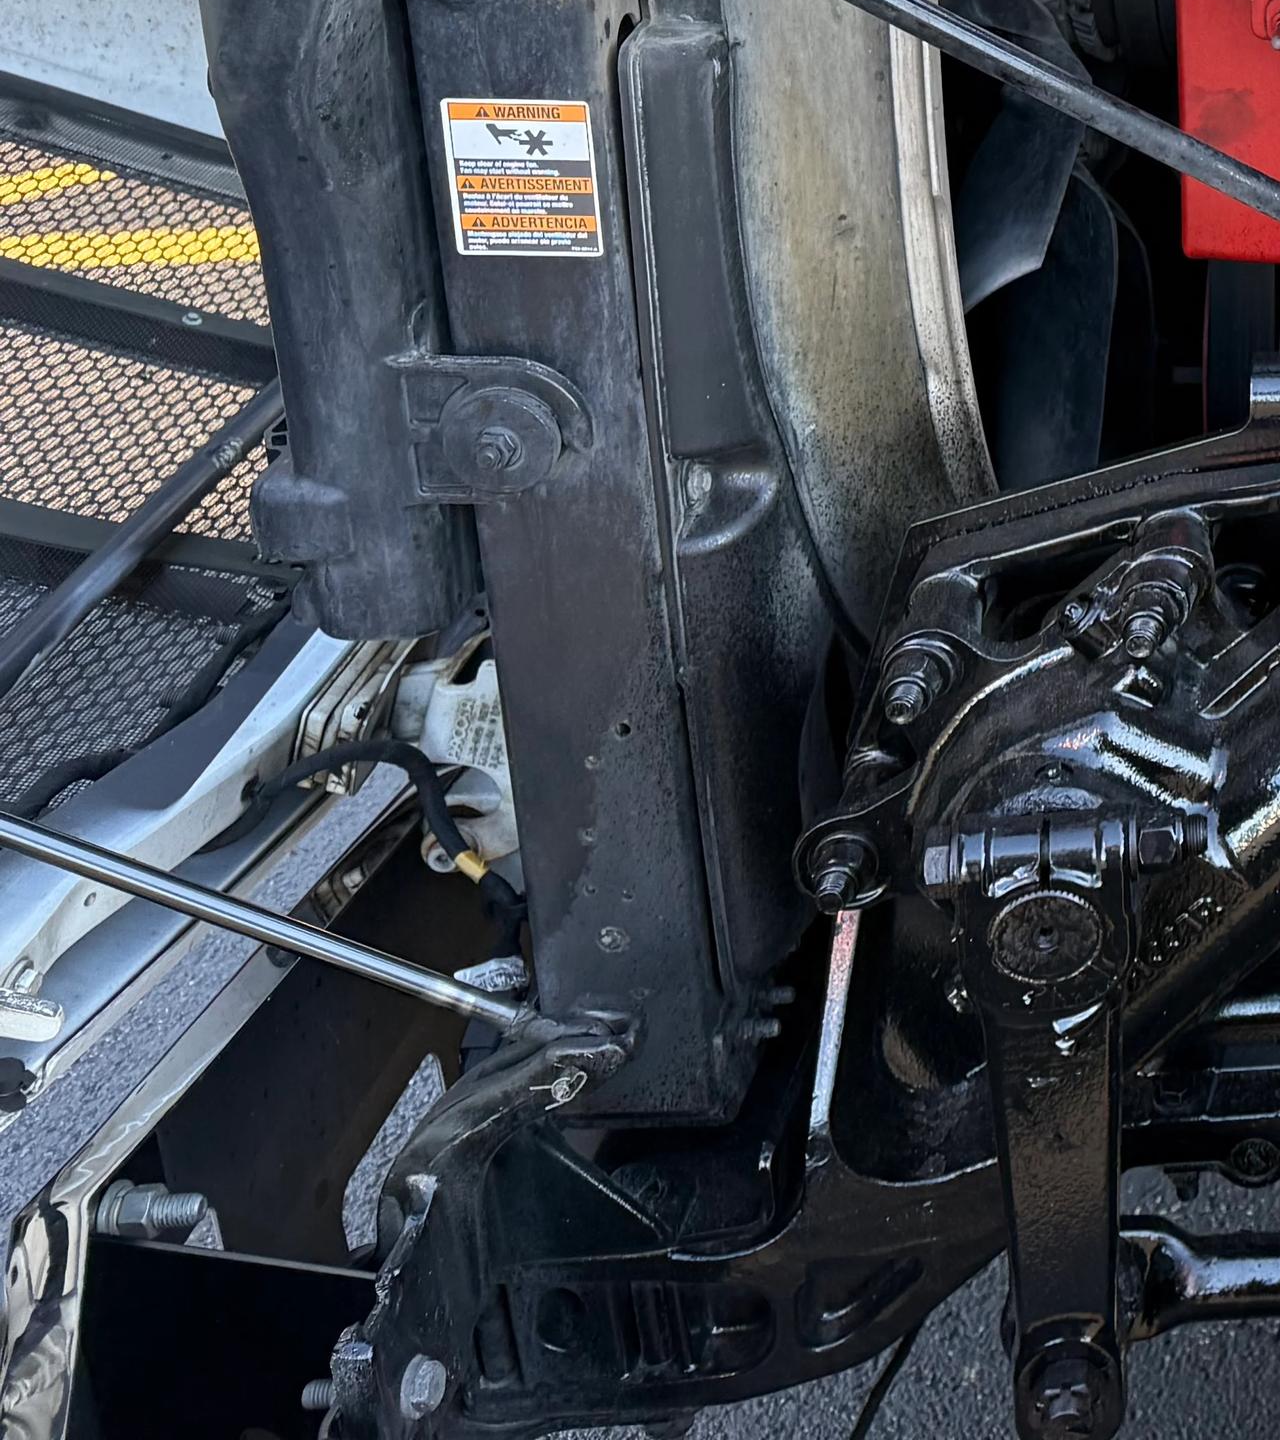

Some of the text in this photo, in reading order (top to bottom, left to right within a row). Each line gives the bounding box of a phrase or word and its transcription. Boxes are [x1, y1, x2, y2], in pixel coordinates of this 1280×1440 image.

[492, 106, 561, 119] WARNING
[480, 177, 590, 192] AVERTISSEMENT
[491, 216, 588, 229] ADVERTENCIA
